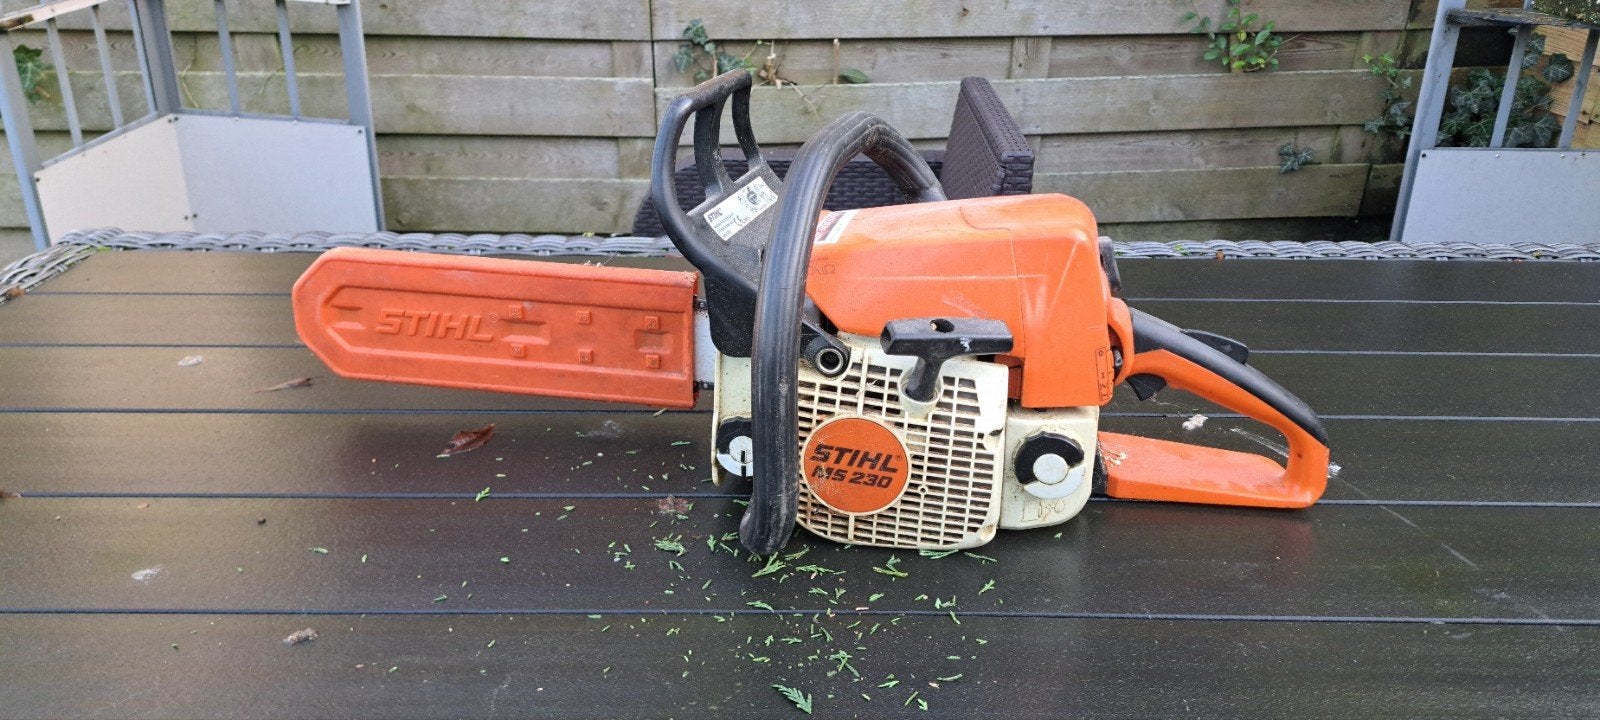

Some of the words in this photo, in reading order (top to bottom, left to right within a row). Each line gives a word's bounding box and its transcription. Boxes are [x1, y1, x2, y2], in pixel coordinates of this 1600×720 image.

[376, 308, 493, 342] STIHL
[810, 443, 898, 473] STIHL
[811, 465, 848, 482] MS
[848, 472, 893, 489] 230
